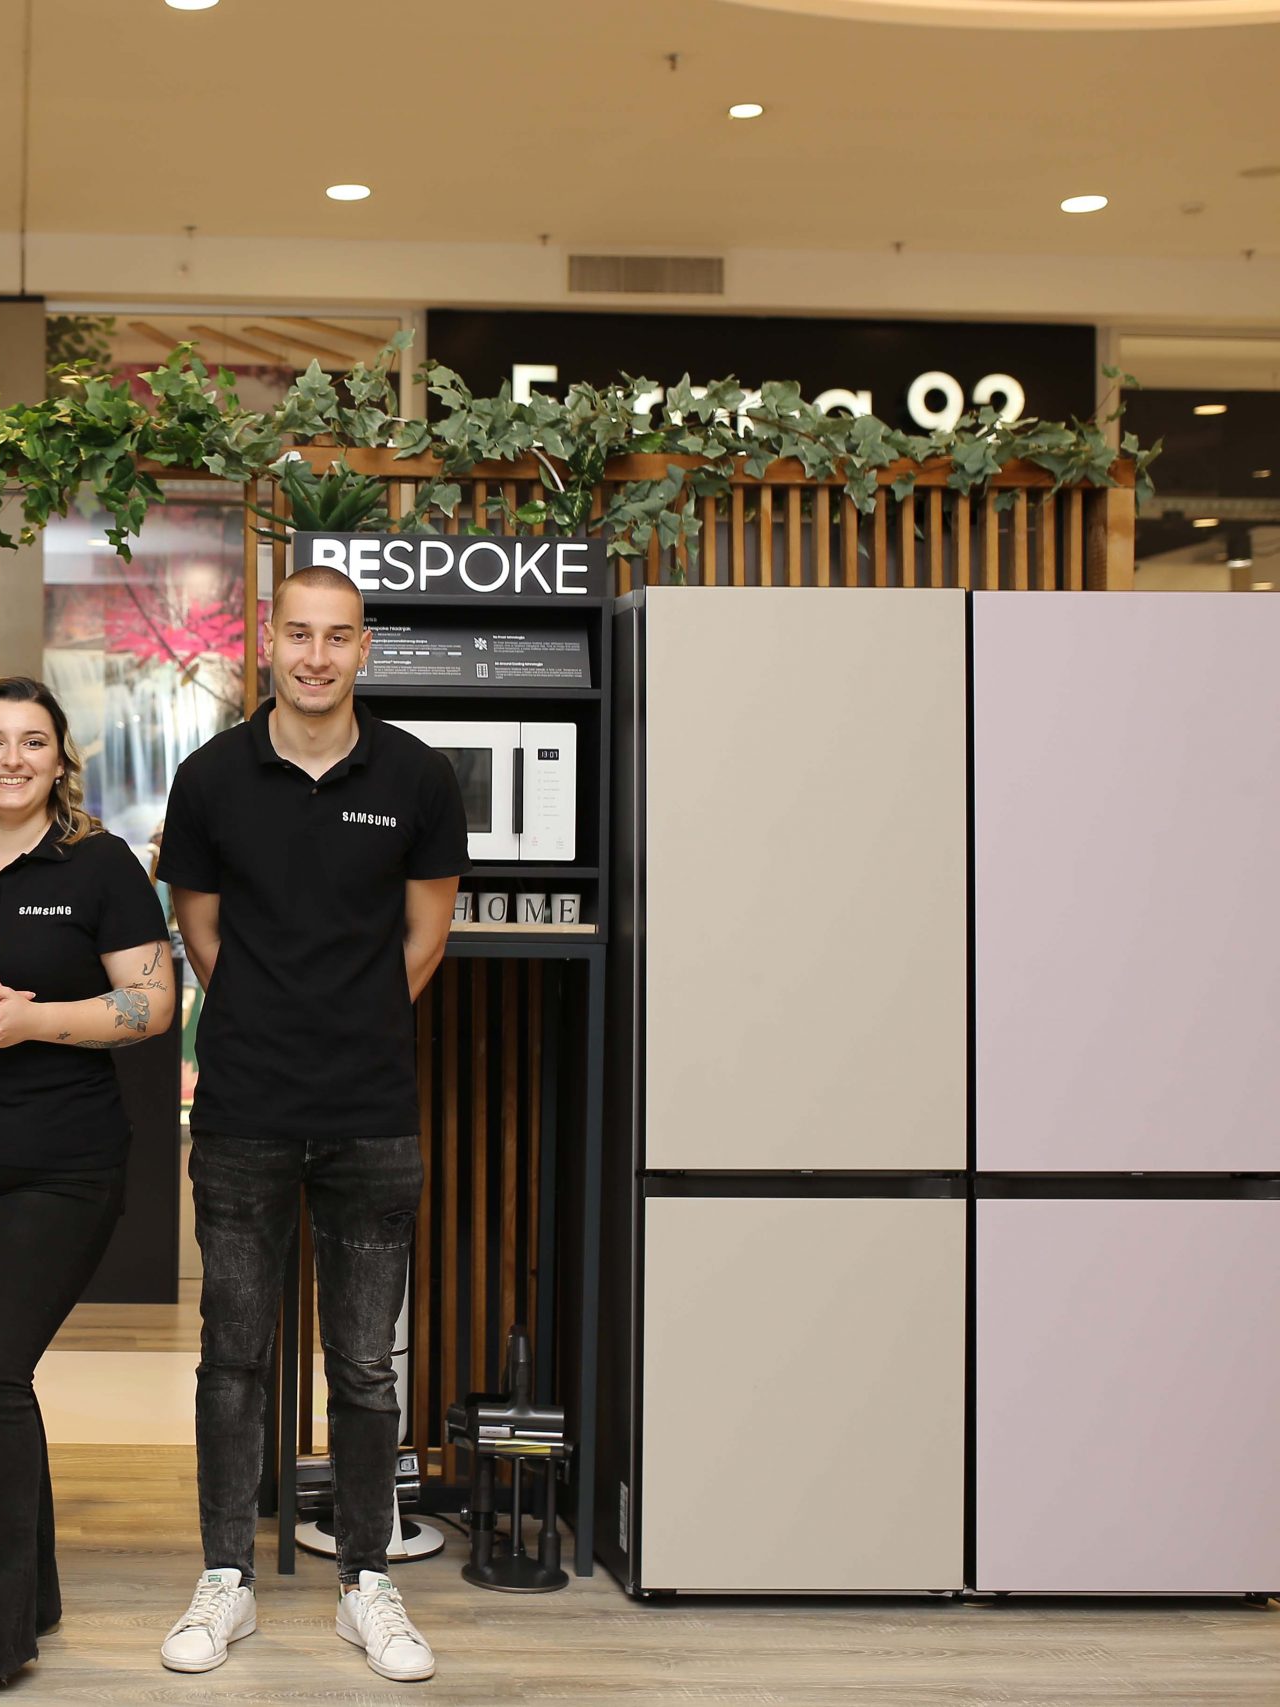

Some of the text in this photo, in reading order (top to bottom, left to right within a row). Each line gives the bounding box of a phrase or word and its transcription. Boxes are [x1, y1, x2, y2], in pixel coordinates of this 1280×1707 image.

[312, 538, 589, 595] BESPOKE
[342, 811, 397, 828] SAMSUNG
[18, 905, 72, 916] SAMSUNG
